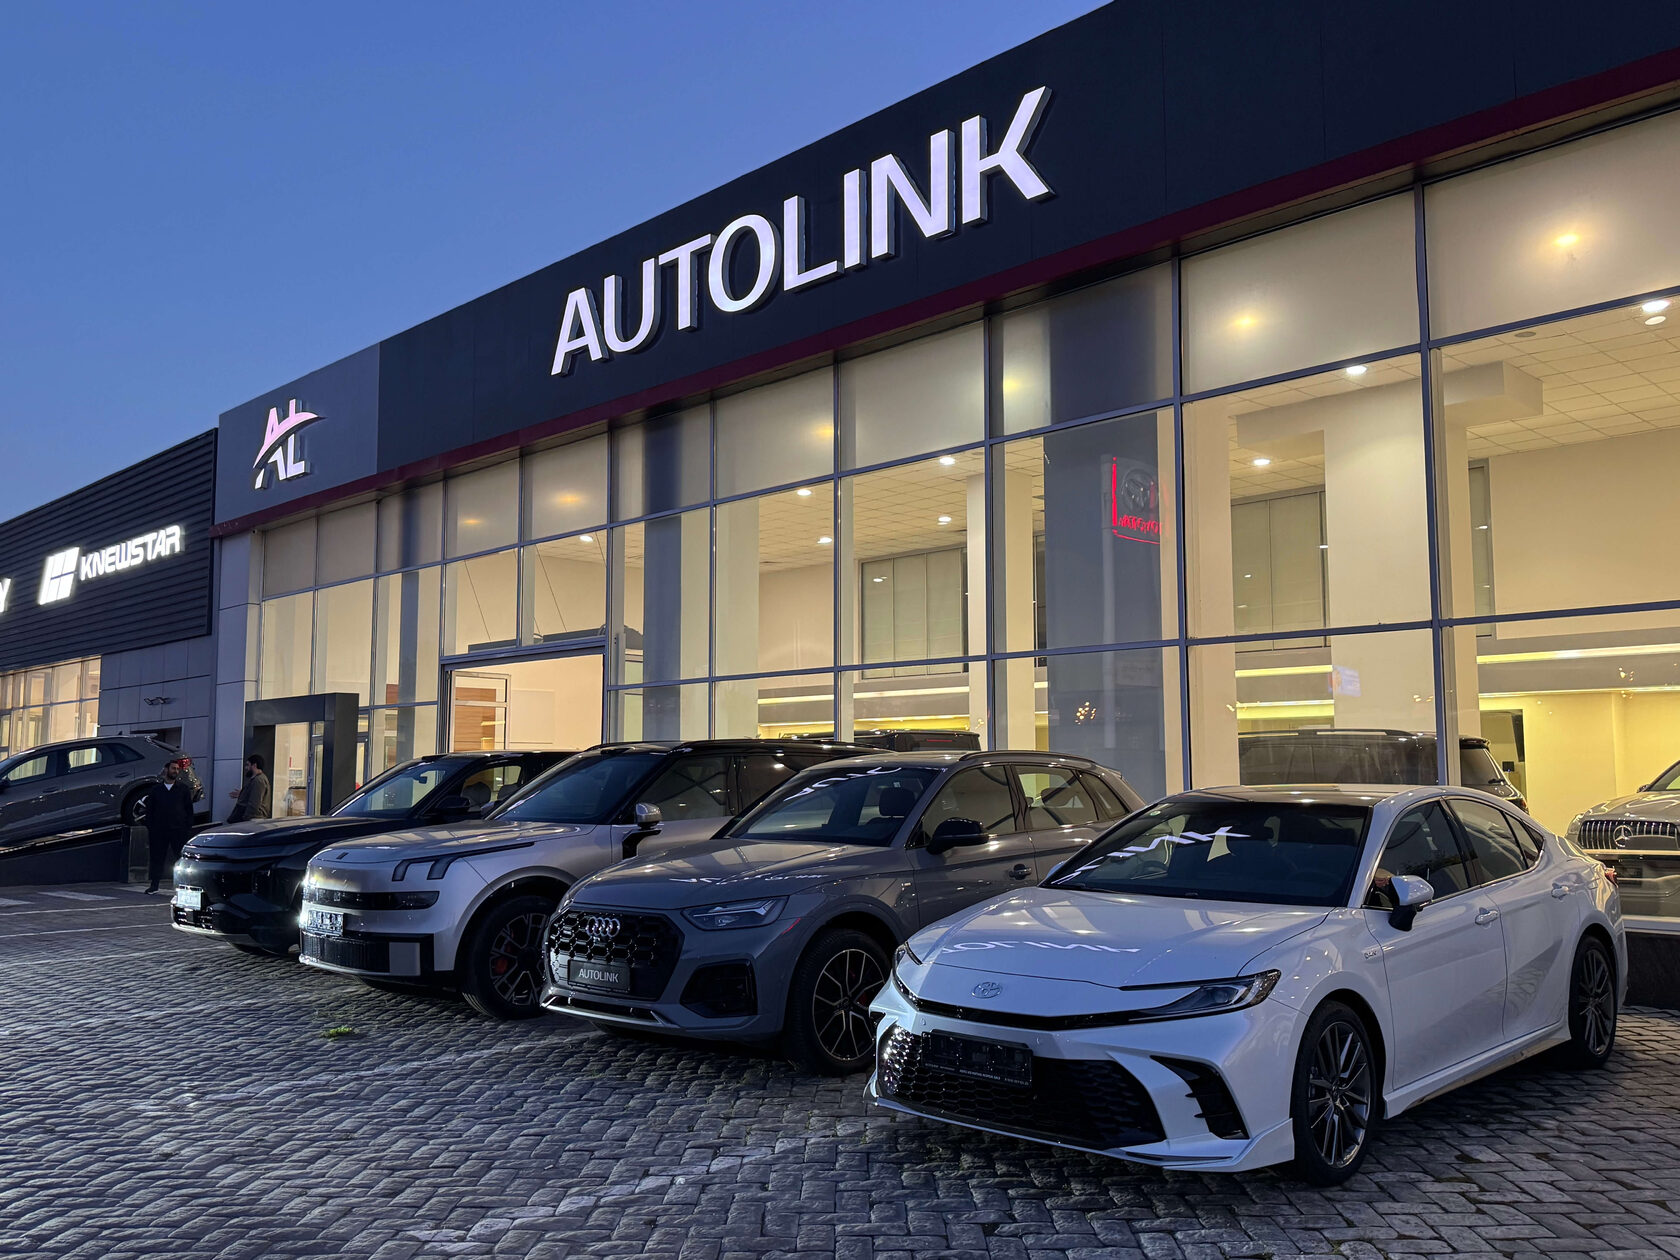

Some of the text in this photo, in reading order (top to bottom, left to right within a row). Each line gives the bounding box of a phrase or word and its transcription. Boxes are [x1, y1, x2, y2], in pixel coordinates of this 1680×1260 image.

[551, 86, 1054, 377] AUTOLINK
[80, 524, 182, 582] KNEWSTAR
[578, 967, 619, 983] AUTOLINK
